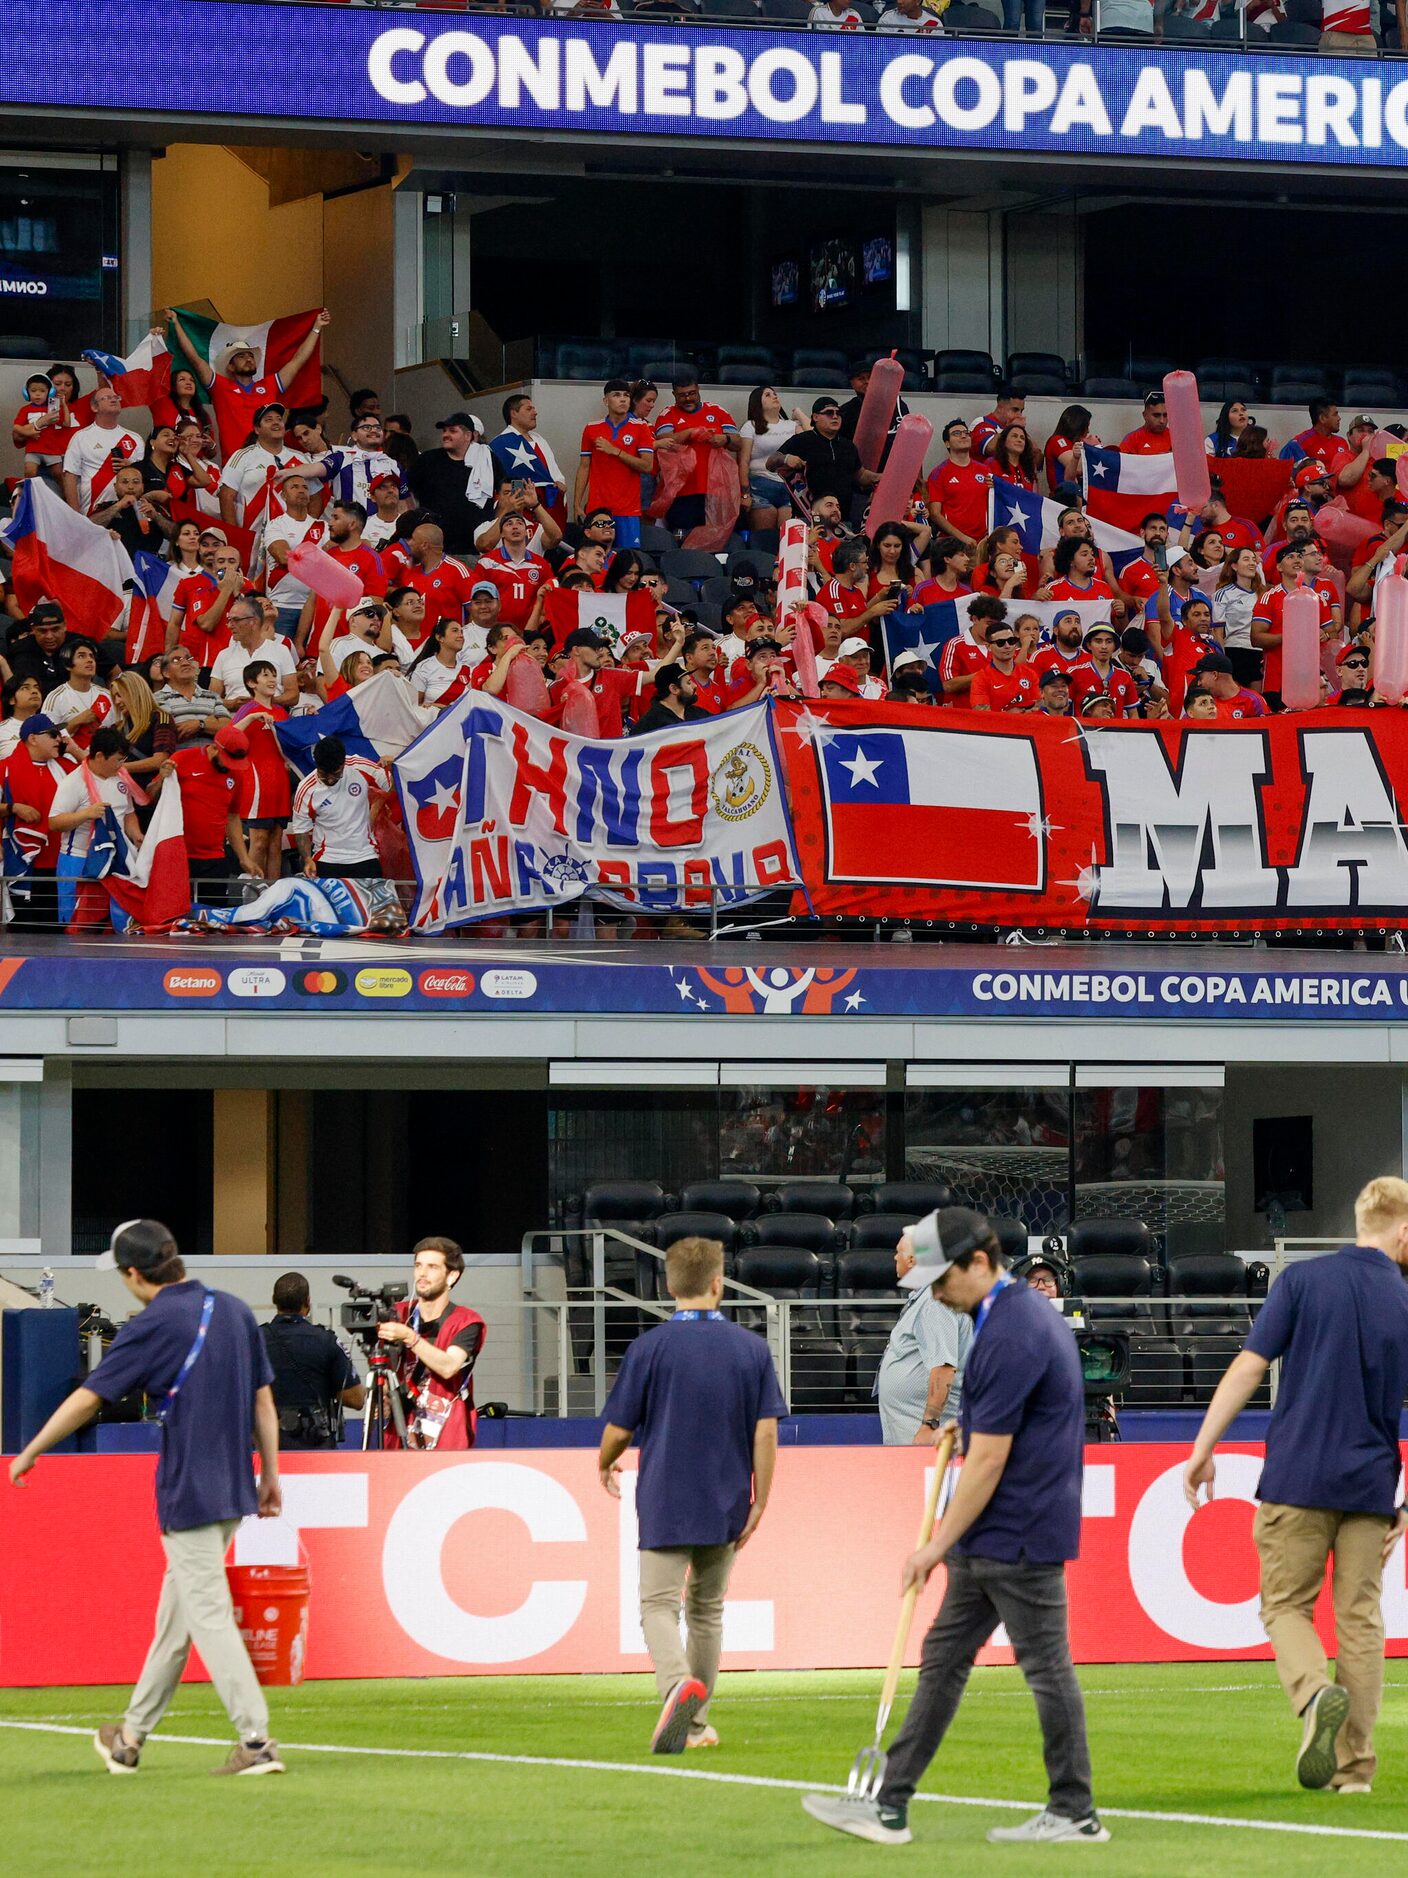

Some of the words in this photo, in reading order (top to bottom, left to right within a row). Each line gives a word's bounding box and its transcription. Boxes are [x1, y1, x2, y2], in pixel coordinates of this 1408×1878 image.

[368, 28, 866, 123] CONMEBOL
[880, 54, 1112, 137] COPA
[168, 976, 217, 989] Betano
[241, 976, 271, 984] ULTRA
[972, 973, 1155, 1002] CONMEBOL
[1160, 975, 1247, 1003] COPA
[1250, 977, 1393, 1006] AMERICA
